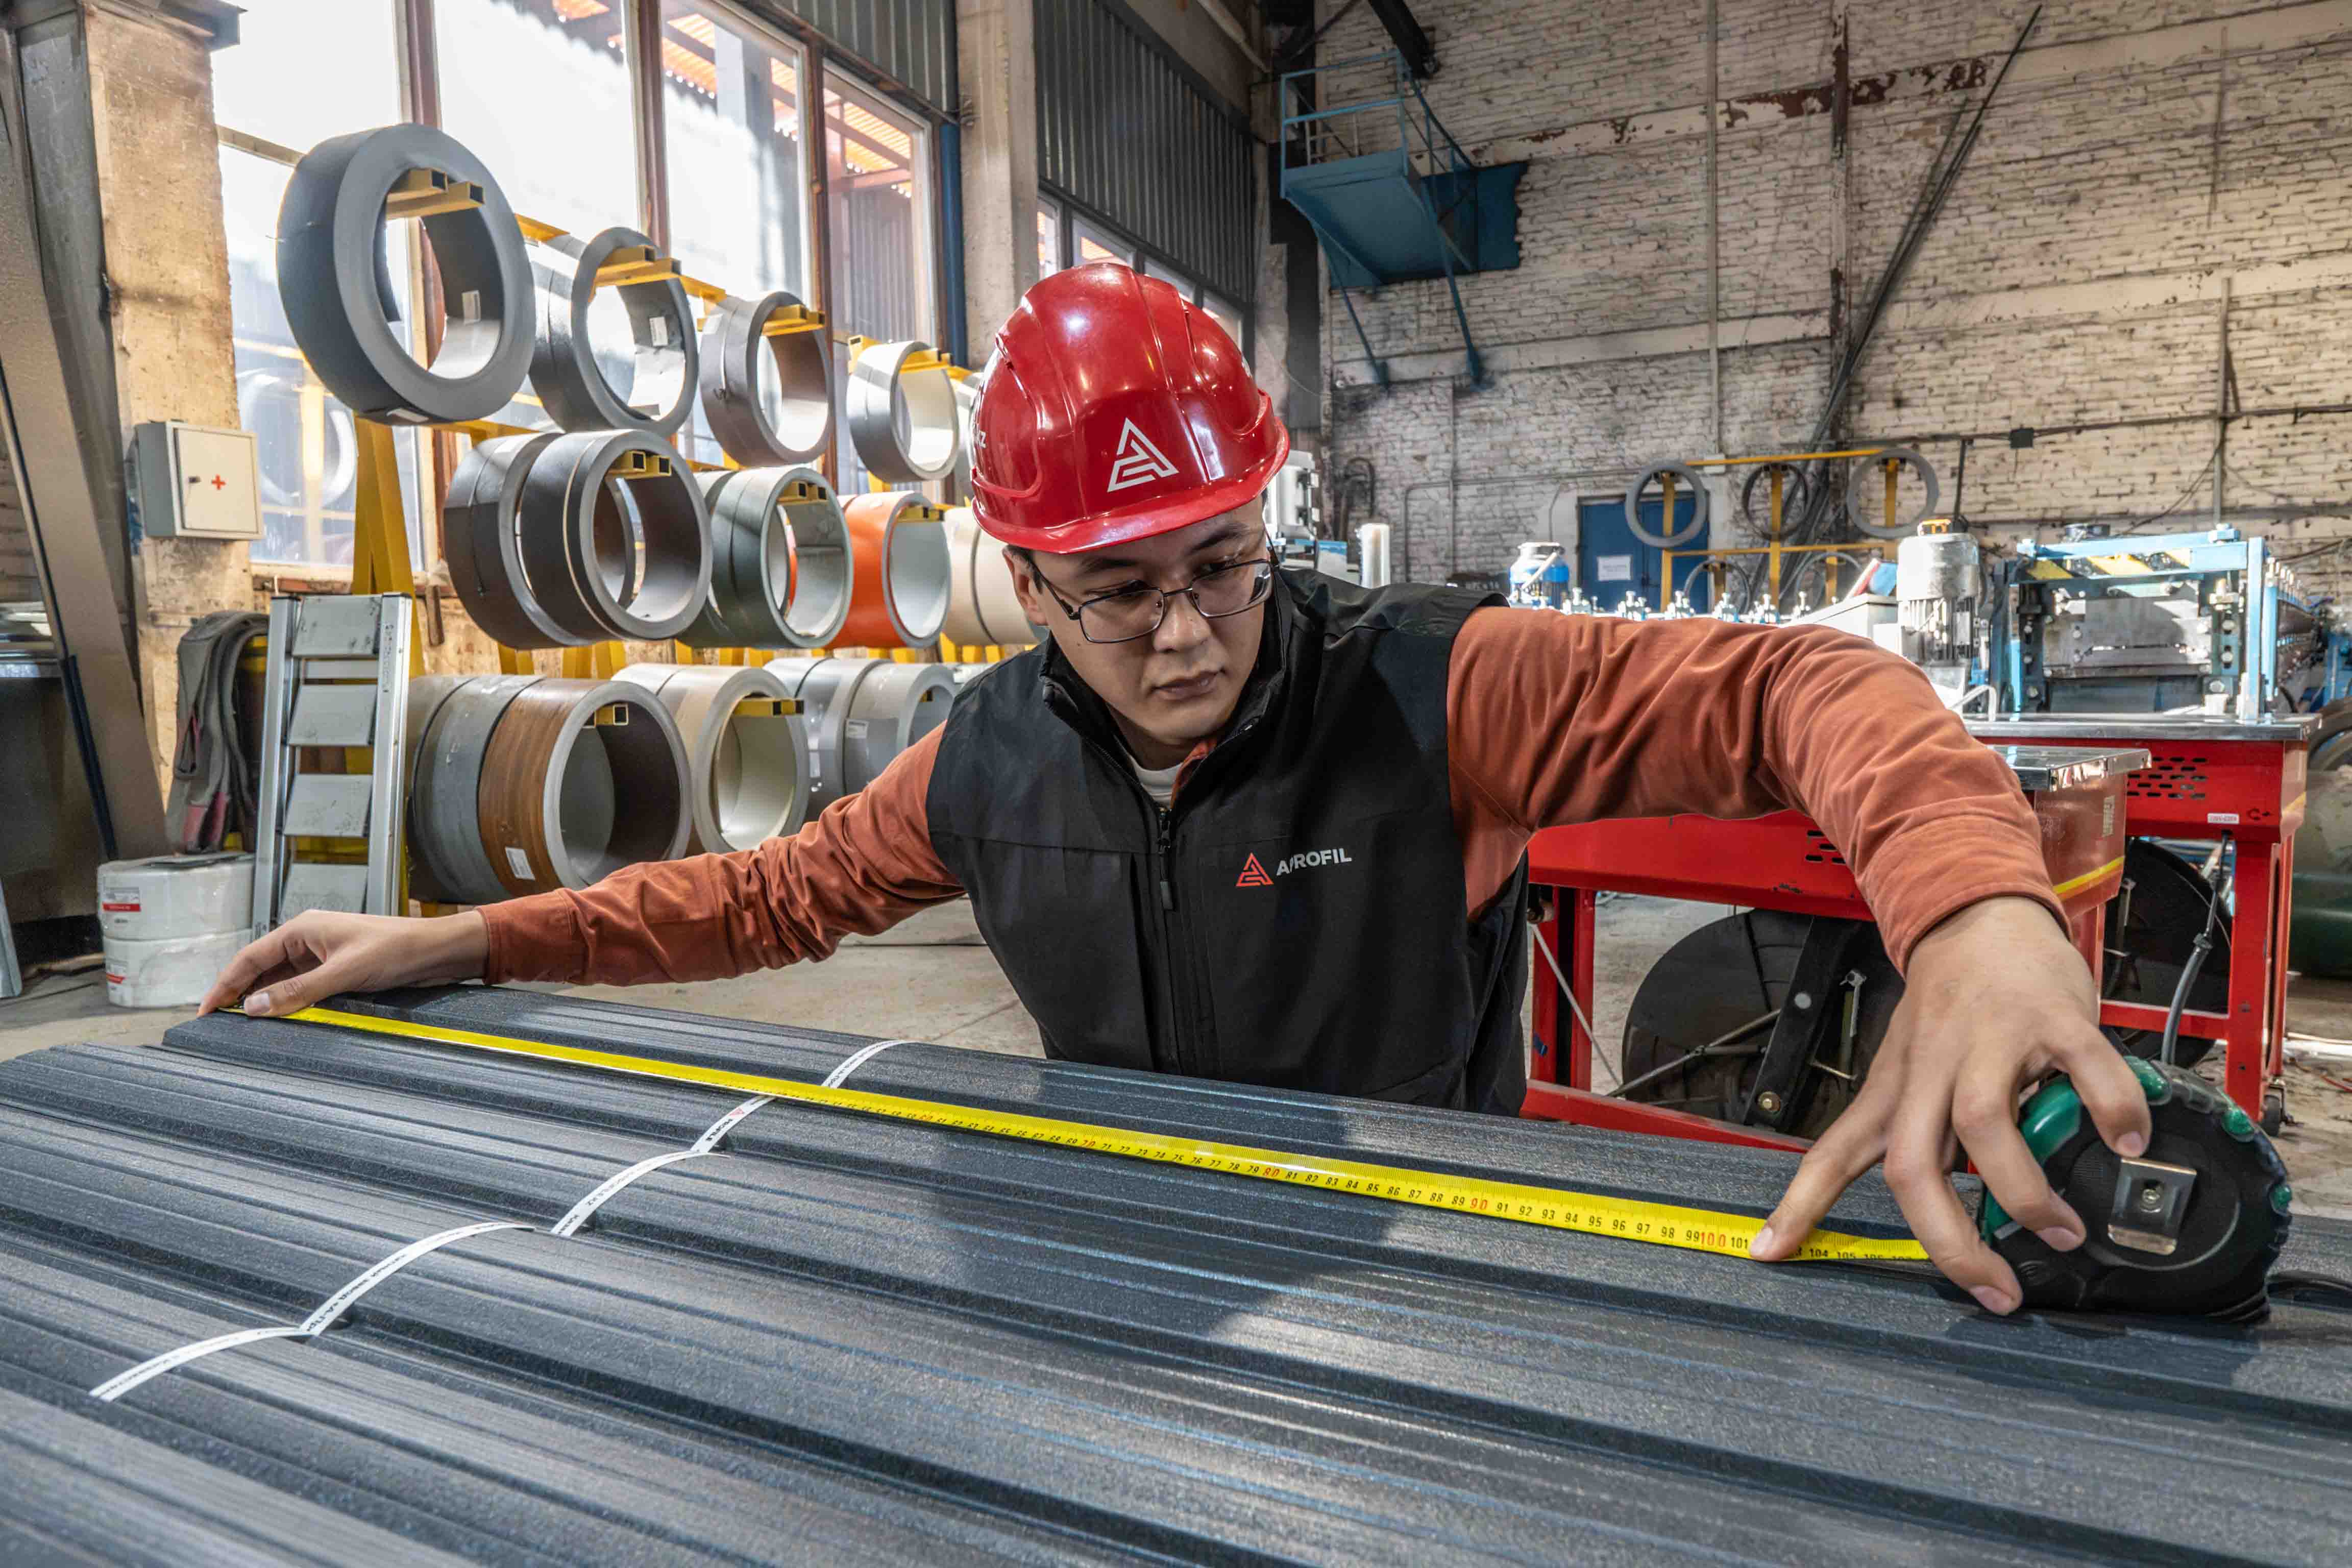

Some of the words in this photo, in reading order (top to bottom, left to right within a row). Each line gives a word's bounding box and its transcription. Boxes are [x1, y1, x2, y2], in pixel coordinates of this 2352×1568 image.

[1284, 1171, 1298, 1180] 81
[1305, 1174, 1318, 1184] 82
[1325, 1177, 1339, 1186] 83
[1345, 1180, 1359, 1189] 84
[1366, 1183, 1380, 1193] 85
[1386, 1186, 1400, 1196] 86
[1408, 1188, 1422, 1199] 87
[1430, 1192, 1444, 1203] 88
[1451, 1195, 1465, 1206] 89
[1470, 1198, 1488, 1210] 90
[1497, 1202, 1508, 1213] 91
[1519, 1205, 1532, 1216] 92
[1541, 1208, 1555, 1220] 93
[1564, 1212, 1578, 1223] 94
[1588, 1215, 1602, 1228] 95
[1612, 1219, 1626, 1231] 96
[1636, 1222, 1650, 1235] 97
[1660, 1226, 1675, 1239] 98
[1685, 1229, 1700, 1242] 99
[1730, 1237, 1748, 1250] 101
[1809, 1248, 1828, 1258] 104
